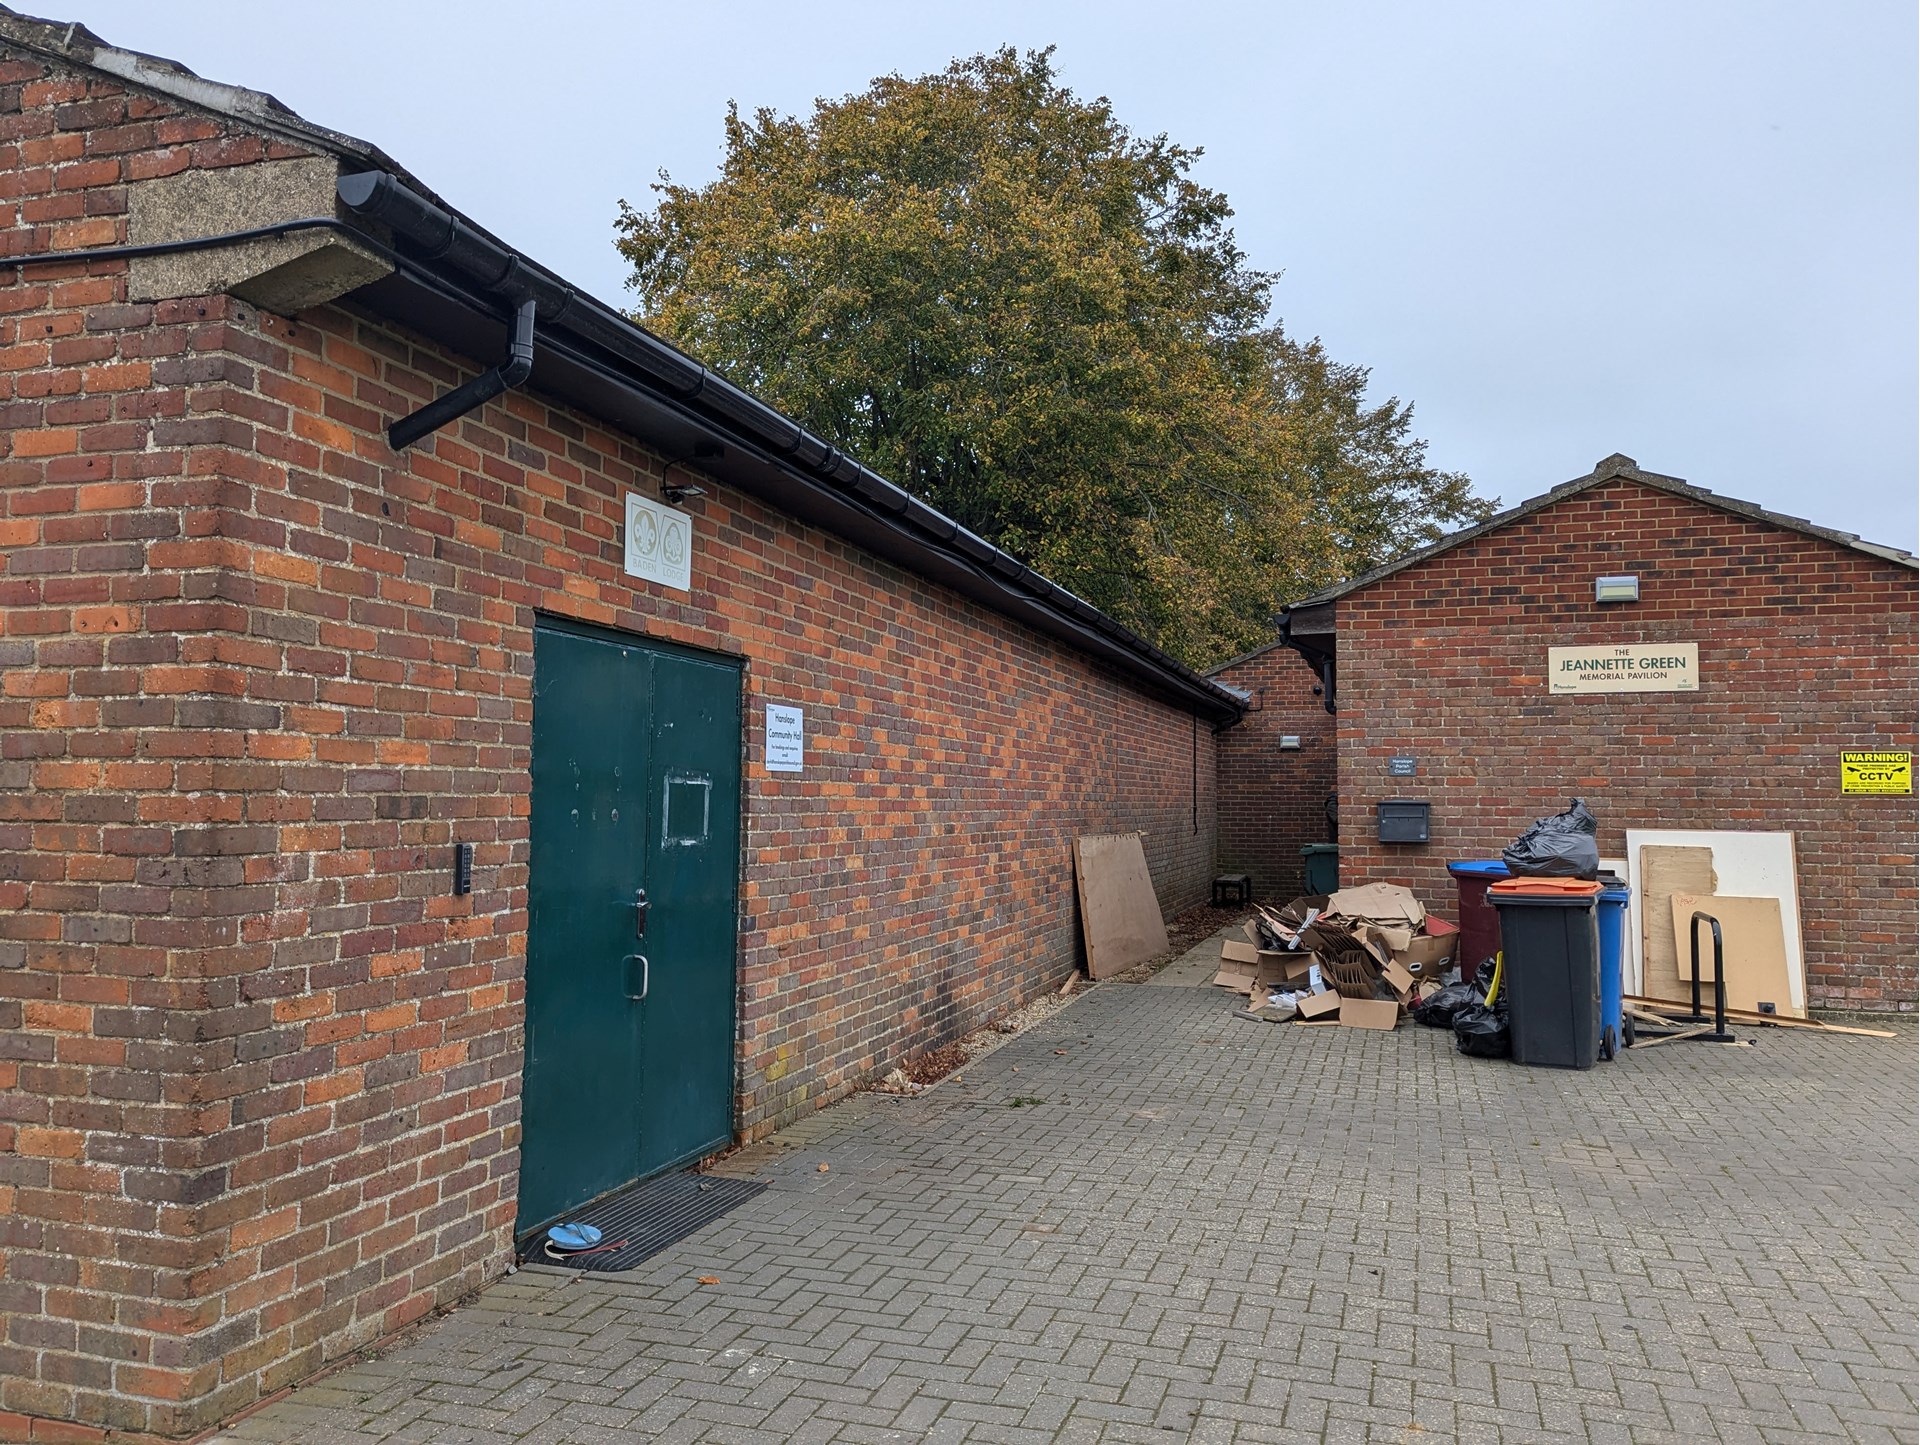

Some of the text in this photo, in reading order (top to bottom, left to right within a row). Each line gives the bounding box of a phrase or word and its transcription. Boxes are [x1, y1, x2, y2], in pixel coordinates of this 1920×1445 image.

[632, 558, 685, 582] BADEN LODGE
[1560, 657, 1686, 671] JEANNETTE GREEN
[1579, 671, 1668, 680] MEMORIAL PAVILION
[775, 713, 796, 726] Hanslope
[768, 728, 802, 742] Community Hall
[1845, 753, 1908, 761] WARNING!
[1859, 772, 1894, 781] CCTV
